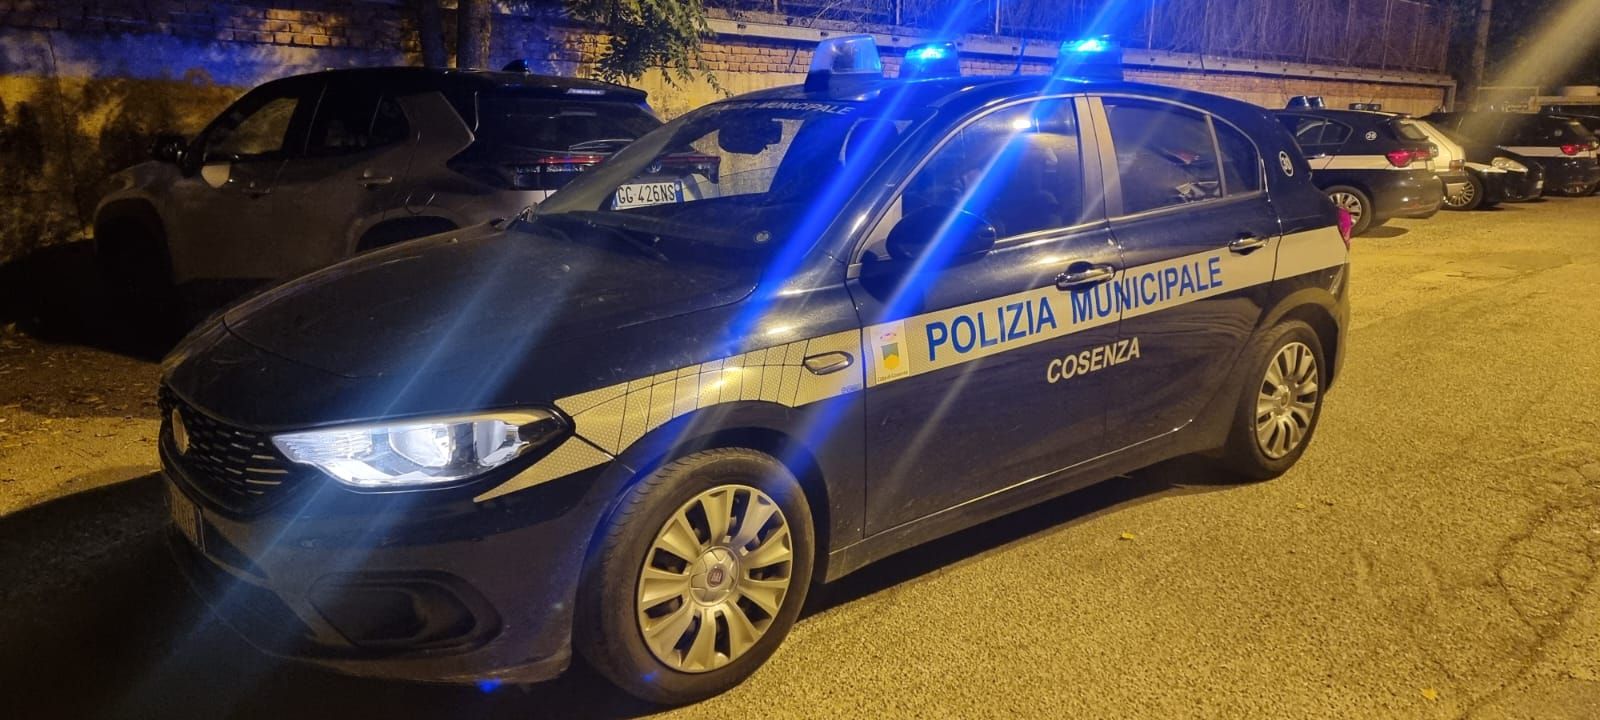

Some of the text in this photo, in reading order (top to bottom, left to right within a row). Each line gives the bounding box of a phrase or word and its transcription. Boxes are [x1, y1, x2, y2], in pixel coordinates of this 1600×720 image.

[617, 184, 675, 204] GG 426NS
[926, 256, 1223, 361] POLIZIA MUNICIPALE
[1046, 336, 1141, 384] COSENZA
